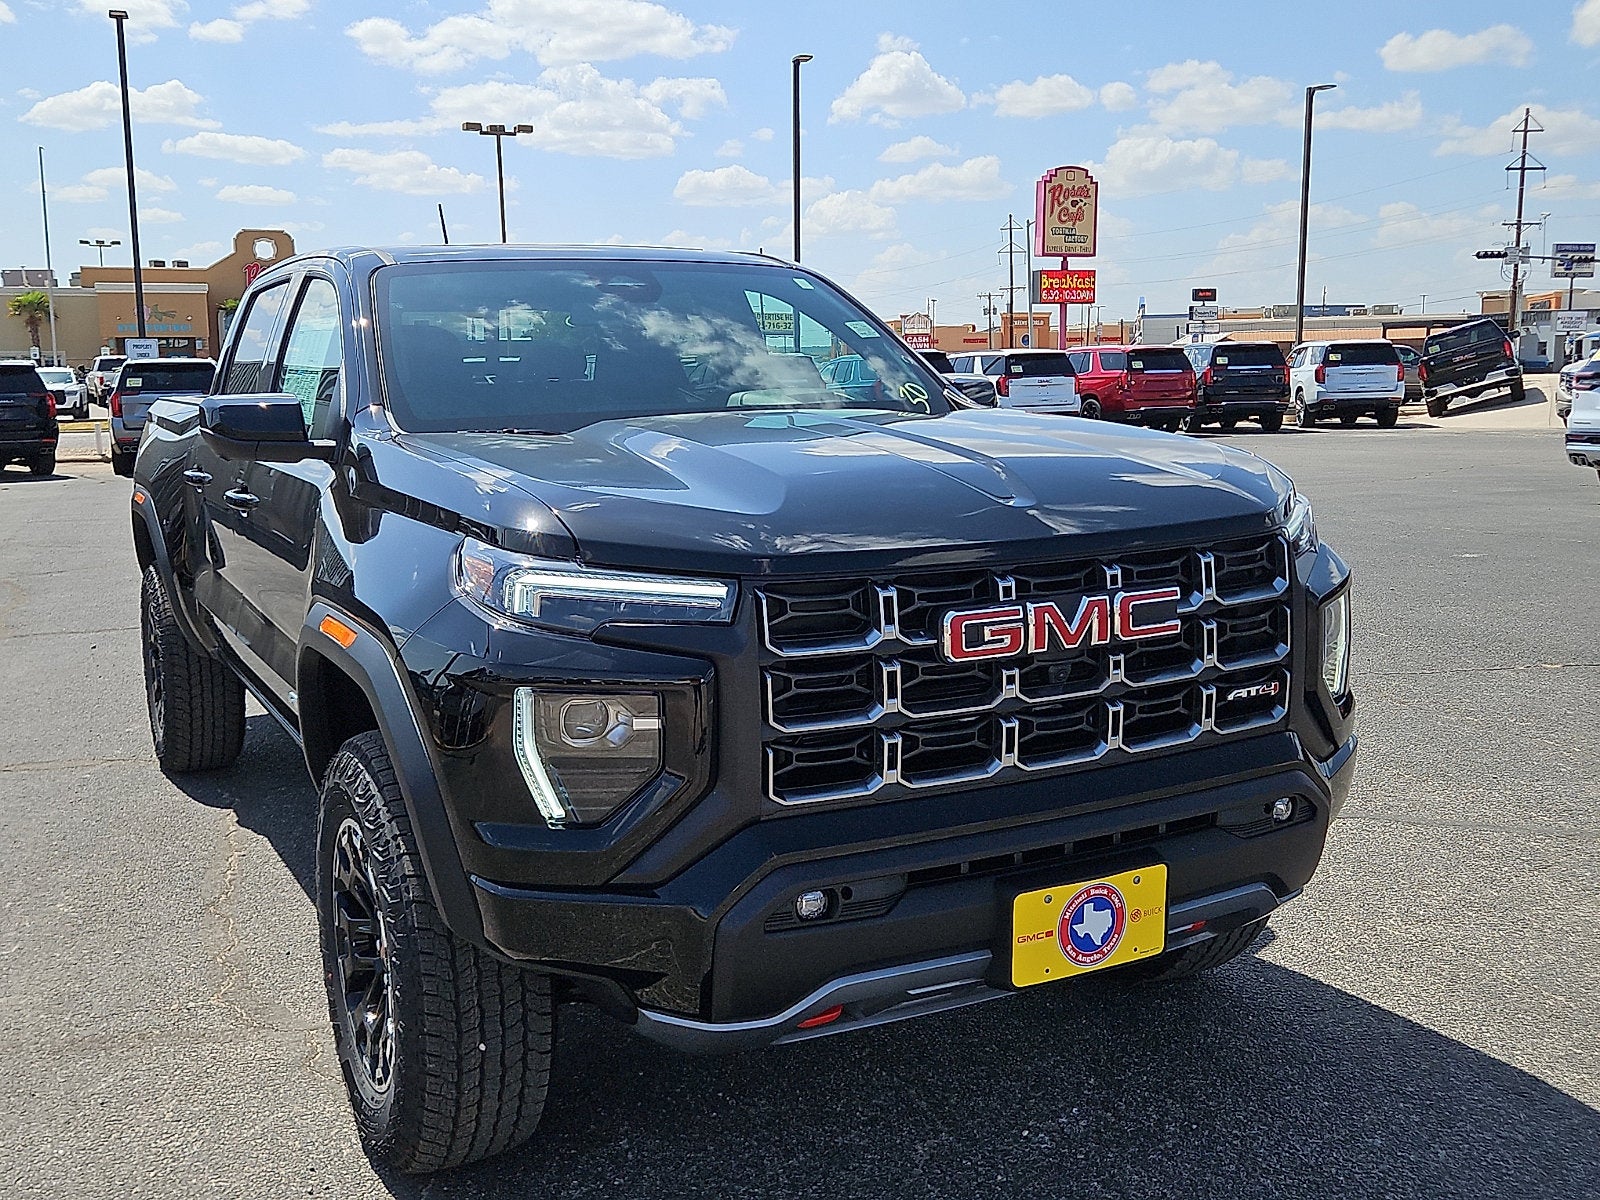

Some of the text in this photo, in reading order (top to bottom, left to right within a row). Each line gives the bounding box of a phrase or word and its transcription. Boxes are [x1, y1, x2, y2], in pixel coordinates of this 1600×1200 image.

[1048, 183, 1091, 217] Rosa's
[1051, 227, 1076, 235] TORTILLA
[1065, 235, 1088, 243] FACTORY
[1041, 274, 1095, 289] Breakfast
[943, 587, 1181, 662] GMC
[1227, 682, 1279, 700] AT4
[1064, 888, 1122, 920] Mitchell Buick GMC
[1143, 906, 1162, 917] BUICK
[1017, 932, 1045, 944] GMC
[1065, 944, 1077, 958] San
[1102, 933, 1119, 954] Texas
